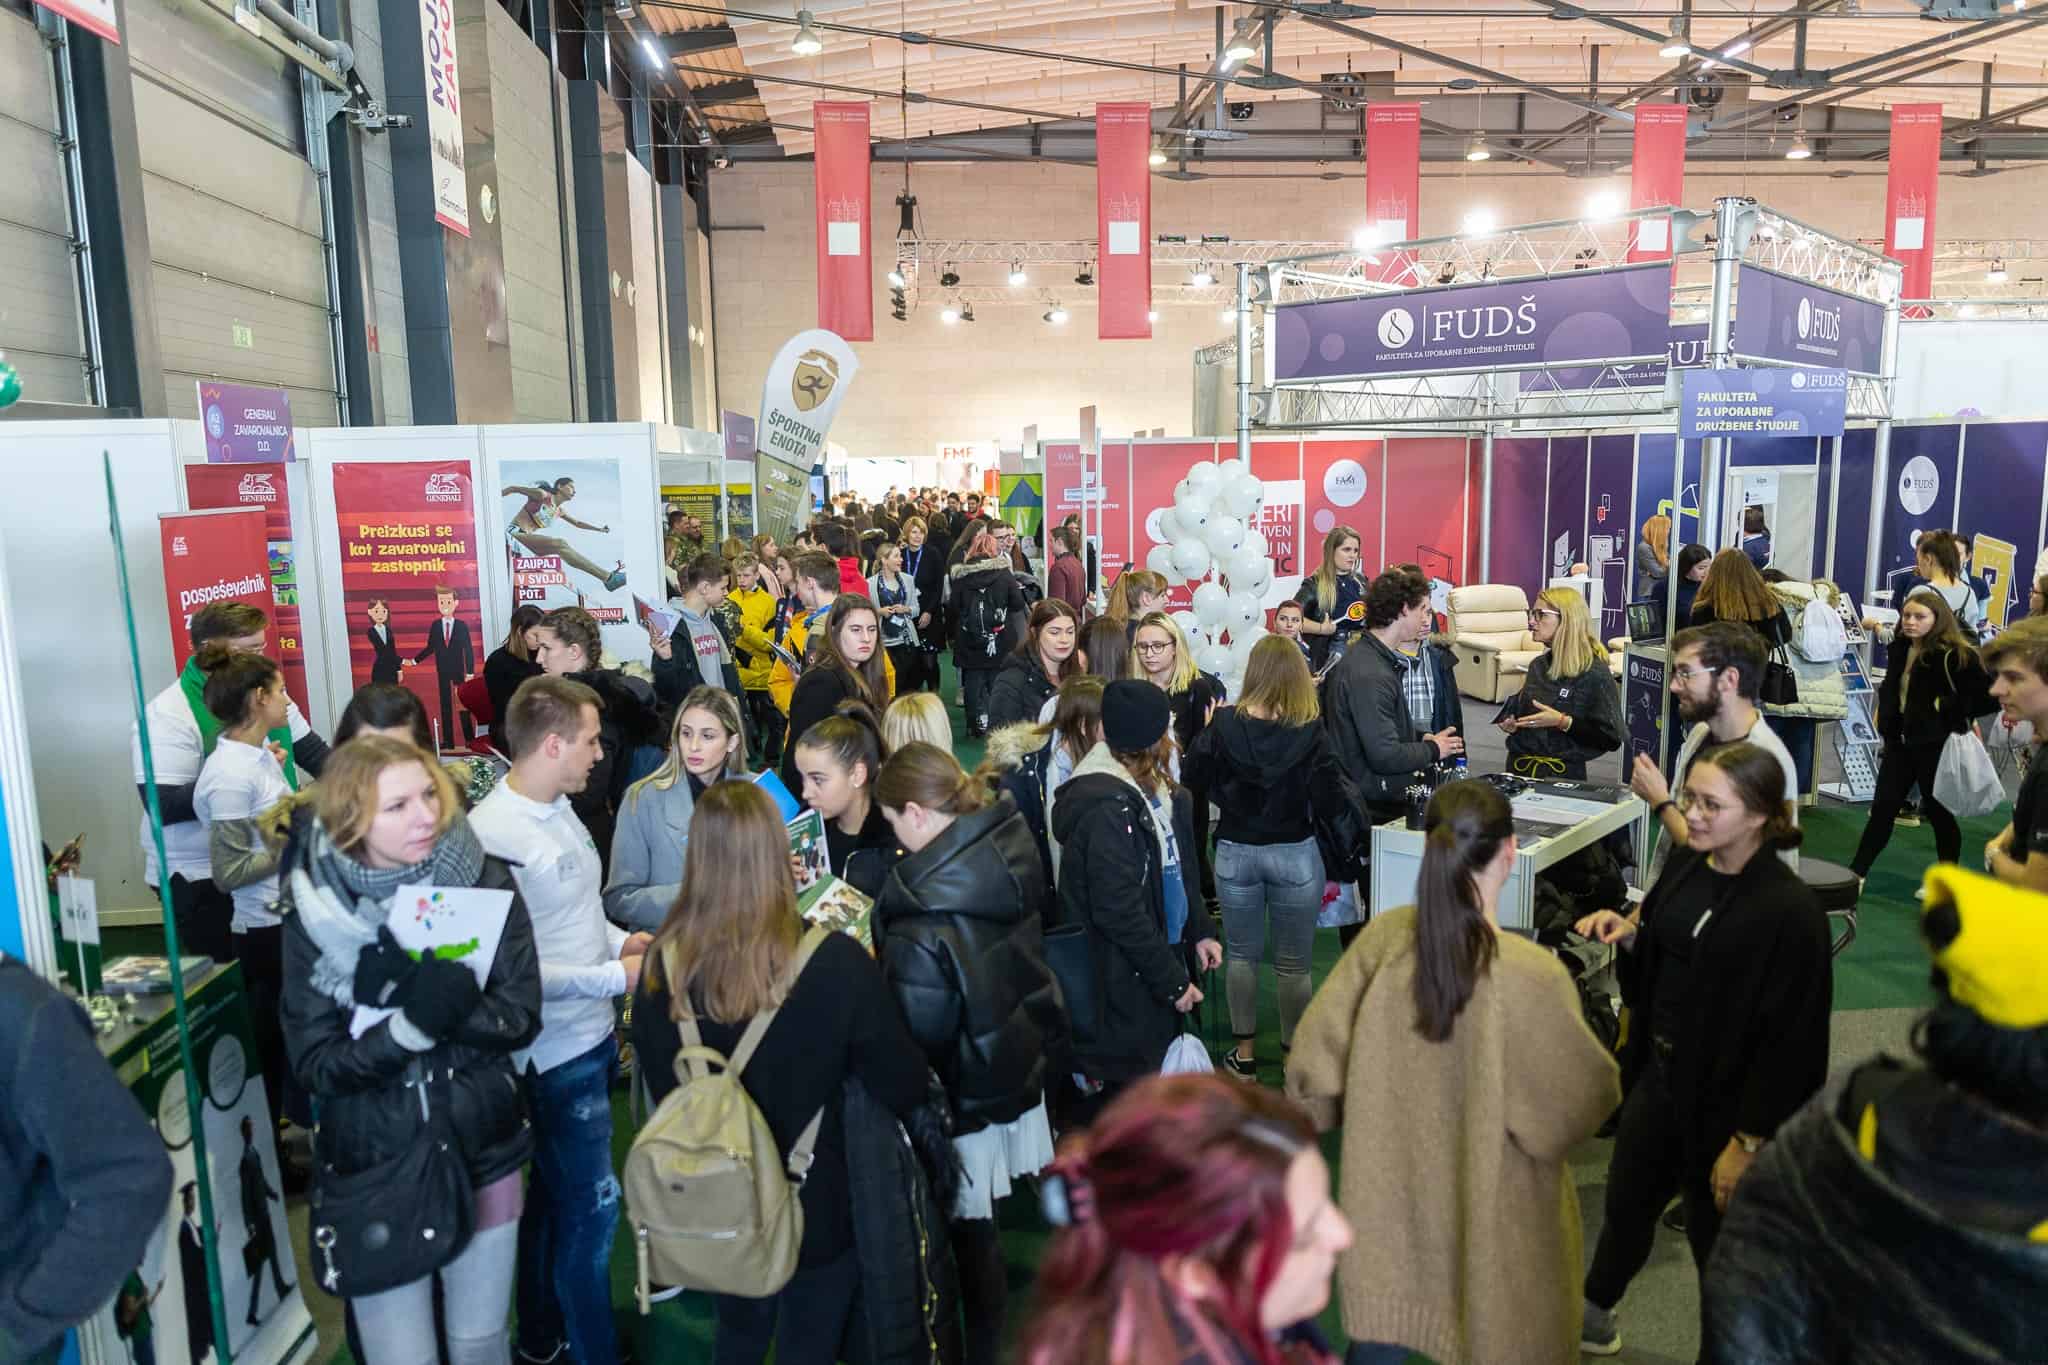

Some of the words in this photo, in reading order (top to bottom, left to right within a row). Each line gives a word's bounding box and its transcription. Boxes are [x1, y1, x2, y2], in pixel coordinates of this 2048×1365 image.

[425, 0, 444, 107] MOJ
[1432, 294, 1537, 342] FUDŠ
[1813, 307, 1841, 342] FUDŠ
[1375, 353, 1413, 361] FAKULTETA
[1414, 351, 1424, 359] ZA
[1811, 371, 1846, 387] FUDŠ
[1697, 392, 1758, 402] FAKULTETA
[243, 408, 277, 421] GENERALI
[1695, 406, 1712, 417] ZA
[1713, 406, 1774, 417] UPORABNE
[233, 424, 289, 437] ZAVAROVALNICA
[767, 407, 822, 447] ŠPORTNA
[1695, 419, 1754, 432] DRUŽBENE
[1755, 419, 1800, 432] ŠTUDIJE
[769, 430, 808, 459] ENOTA
[1913, 476, 1935, 489] FUDŠ
[239, 494, 277, 502] GENERALI
[426, 494, 462, 502] GENERALI
[359, 523, 431, 538] Preizkusi
[436, 525, 453, 537] se
[348, 541, 373, 557] kot
[377, 540, 466, 556] zavarovalni
[371, 557, 447, 576] zastopnik
[517, 559, 557, 570] ZAUPAJ
[518, 573, 525, 584] V
[528, 573, 564, 584] SVOJO
[180, 572, 267, 611] pospeševalnik
[519, 589, 543, 600] POT.
[1640, 665, 1663, 682] FUDŠ
